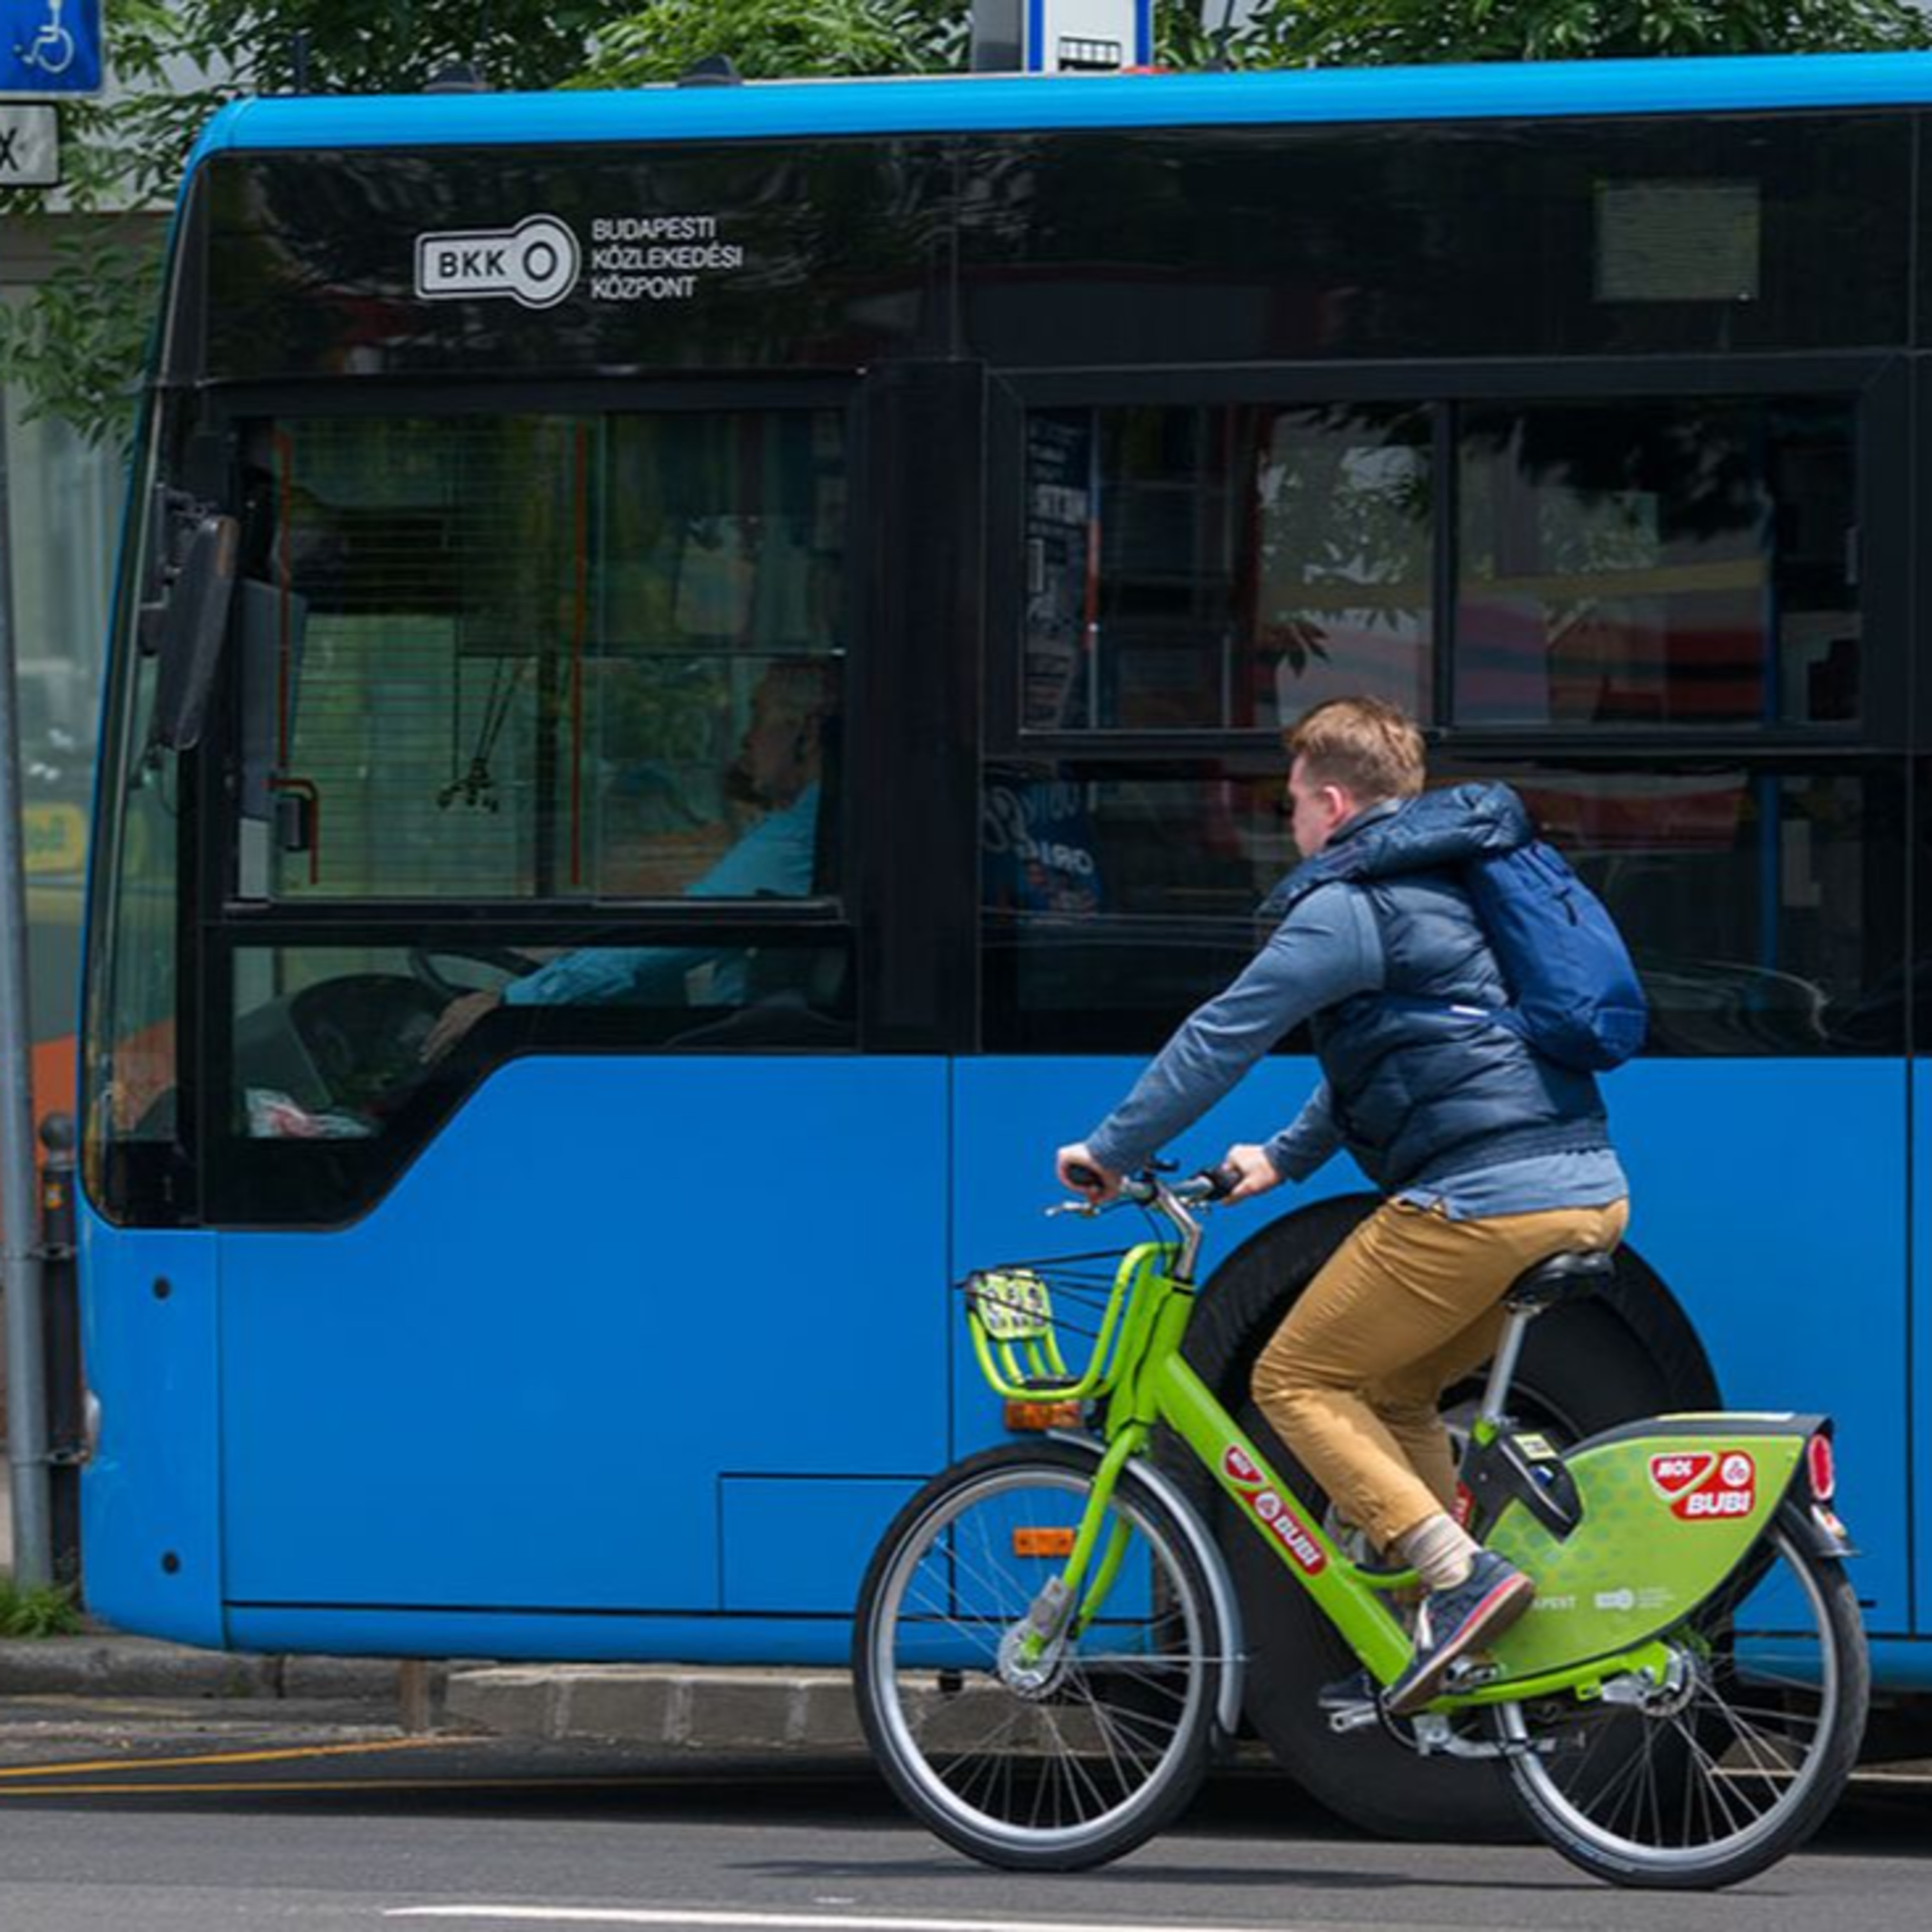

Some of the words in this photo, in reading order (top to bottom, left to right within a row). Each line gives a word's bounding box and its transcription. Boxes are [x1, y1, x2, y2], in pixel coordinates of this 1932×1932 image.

[592, 217, 717, 242] BUDAPESTI
[438, 249, 506, 278] BKK
[591, 242, 743, 270] KÖZLEKEDÉSI
[591, 273, 698, 299] KÖZPONT
[1685, 1491, 1751, 1515] BUBI
[1273, 1515, 1321, 1566] BUBI
